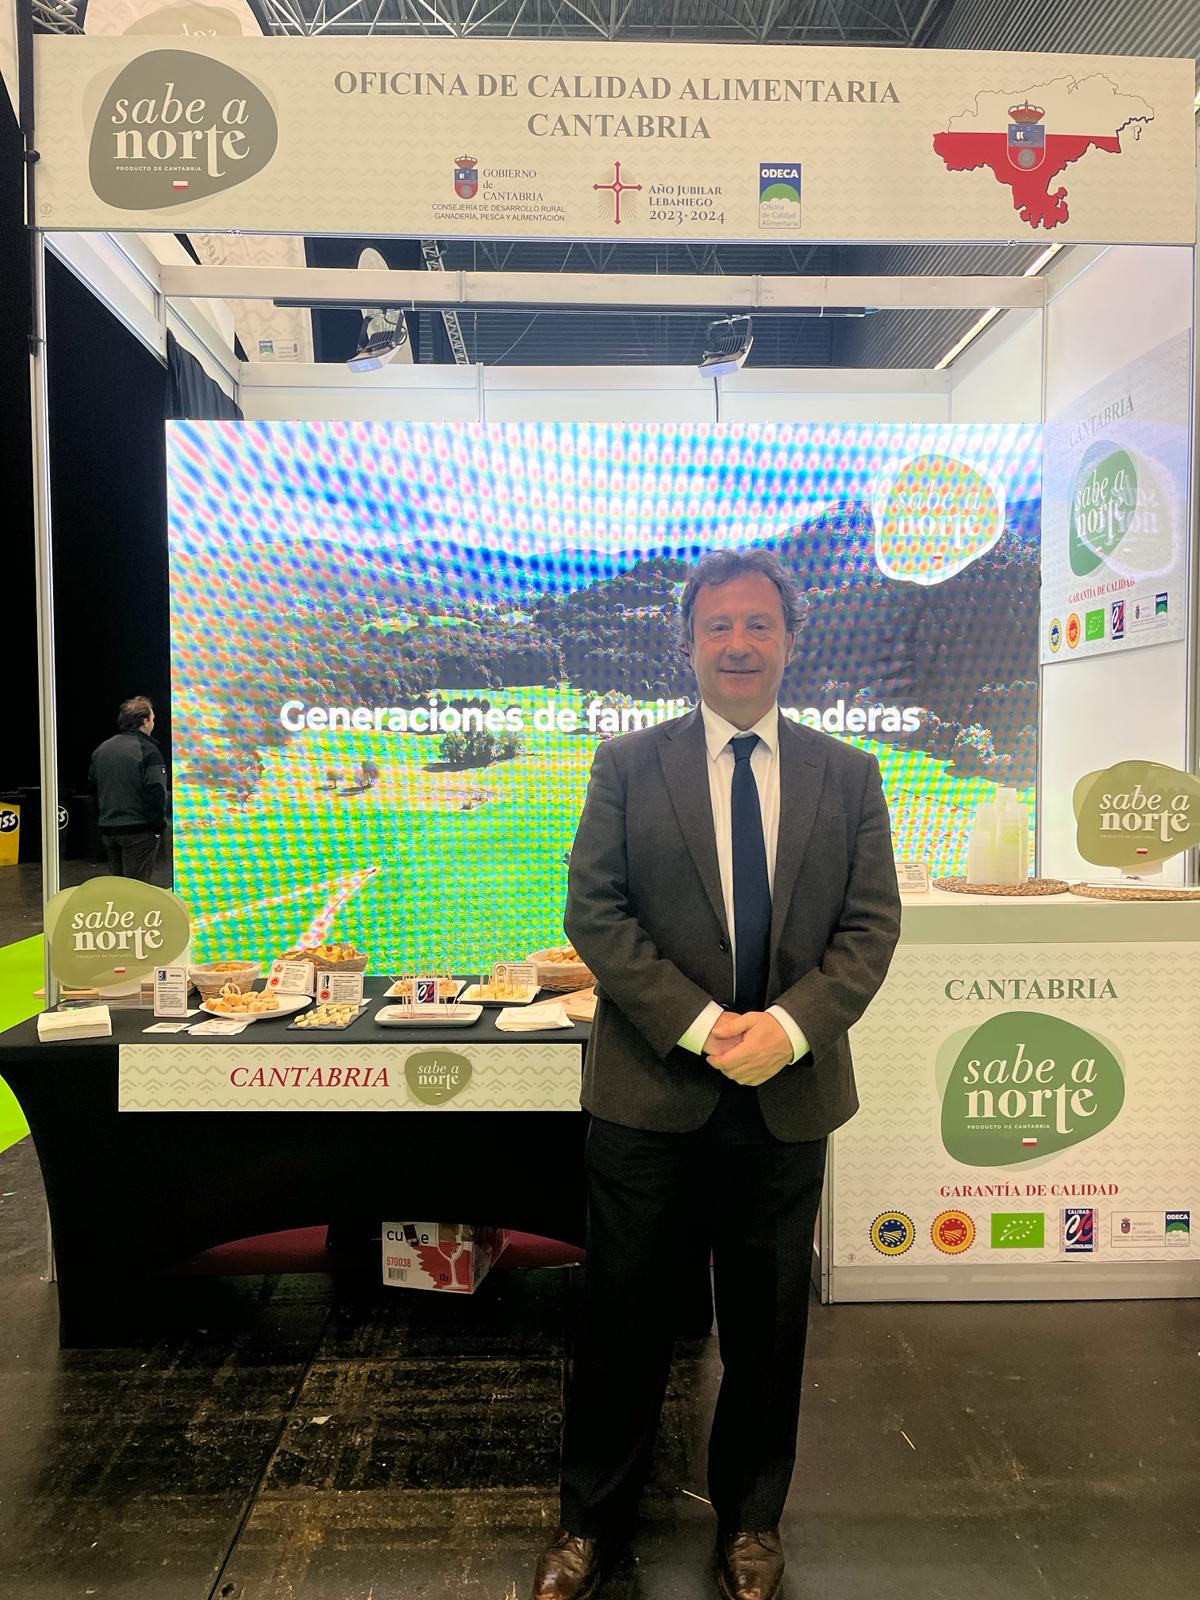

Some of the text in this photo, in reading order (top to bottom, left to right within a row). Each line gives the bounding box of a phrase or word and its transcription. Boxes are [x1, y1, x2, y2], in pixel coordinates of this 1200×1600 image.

[334, 70, 900, 104] OFICINA DE CALIDAD ALIMENTARIA
[111, 82, 249, 125] sabe a
[527, 113, 712, 139] CANTABRIA
[112, 123, 250, 178] norte
[482, 168, 537, 179] GOBIERNO
[482, 180, 493, 189] de
[761, 168, 800, 179] ODECA
[483, 191, 544, 201] CANTABRIA
[648, 183, 722, 196] AÑO JUBILAR
[649, 196, 713, 207] LEBANIEGO
[431, 203, 477, 211] CONSEJERÍA
[479, 204, 489, 212] DE
[490, 204, 540, 213] DESARROLLO
[480, 213, 505, 221] PESCA
[506, 213, 511, 221] Y
[511, 213, 565, 222] ALIMENTACIÓN
[1067, 394, 1135, 448] CANTABRIA
[895, 479, 955, 510] sabe
[896, 510, 980, 550] norte
[279, 698, 921, 733] Generaciones de famili naderas
[1099, 784, 1190, 811] sabe a
[1099, 809, 1190, 842] norte
[71, 901, 163, 930] sabe a
[72, 926, 164, 960] norte
[944, 978, 1119, 1001] CANTABRIA
[417, 1060, 460, 1075] sabe a
[963, 1043, 1098, 1084] sabe a
[229, 1066, 390, 1088] CANTABRIA
[418, 1073, 461, 1090] norte
[964, 1082, 1098, 1135] norte
[939, 1181, 1120, 1198] GARANTÍA DE CALIDAD
[386, 1229, 430, 1245] cue
